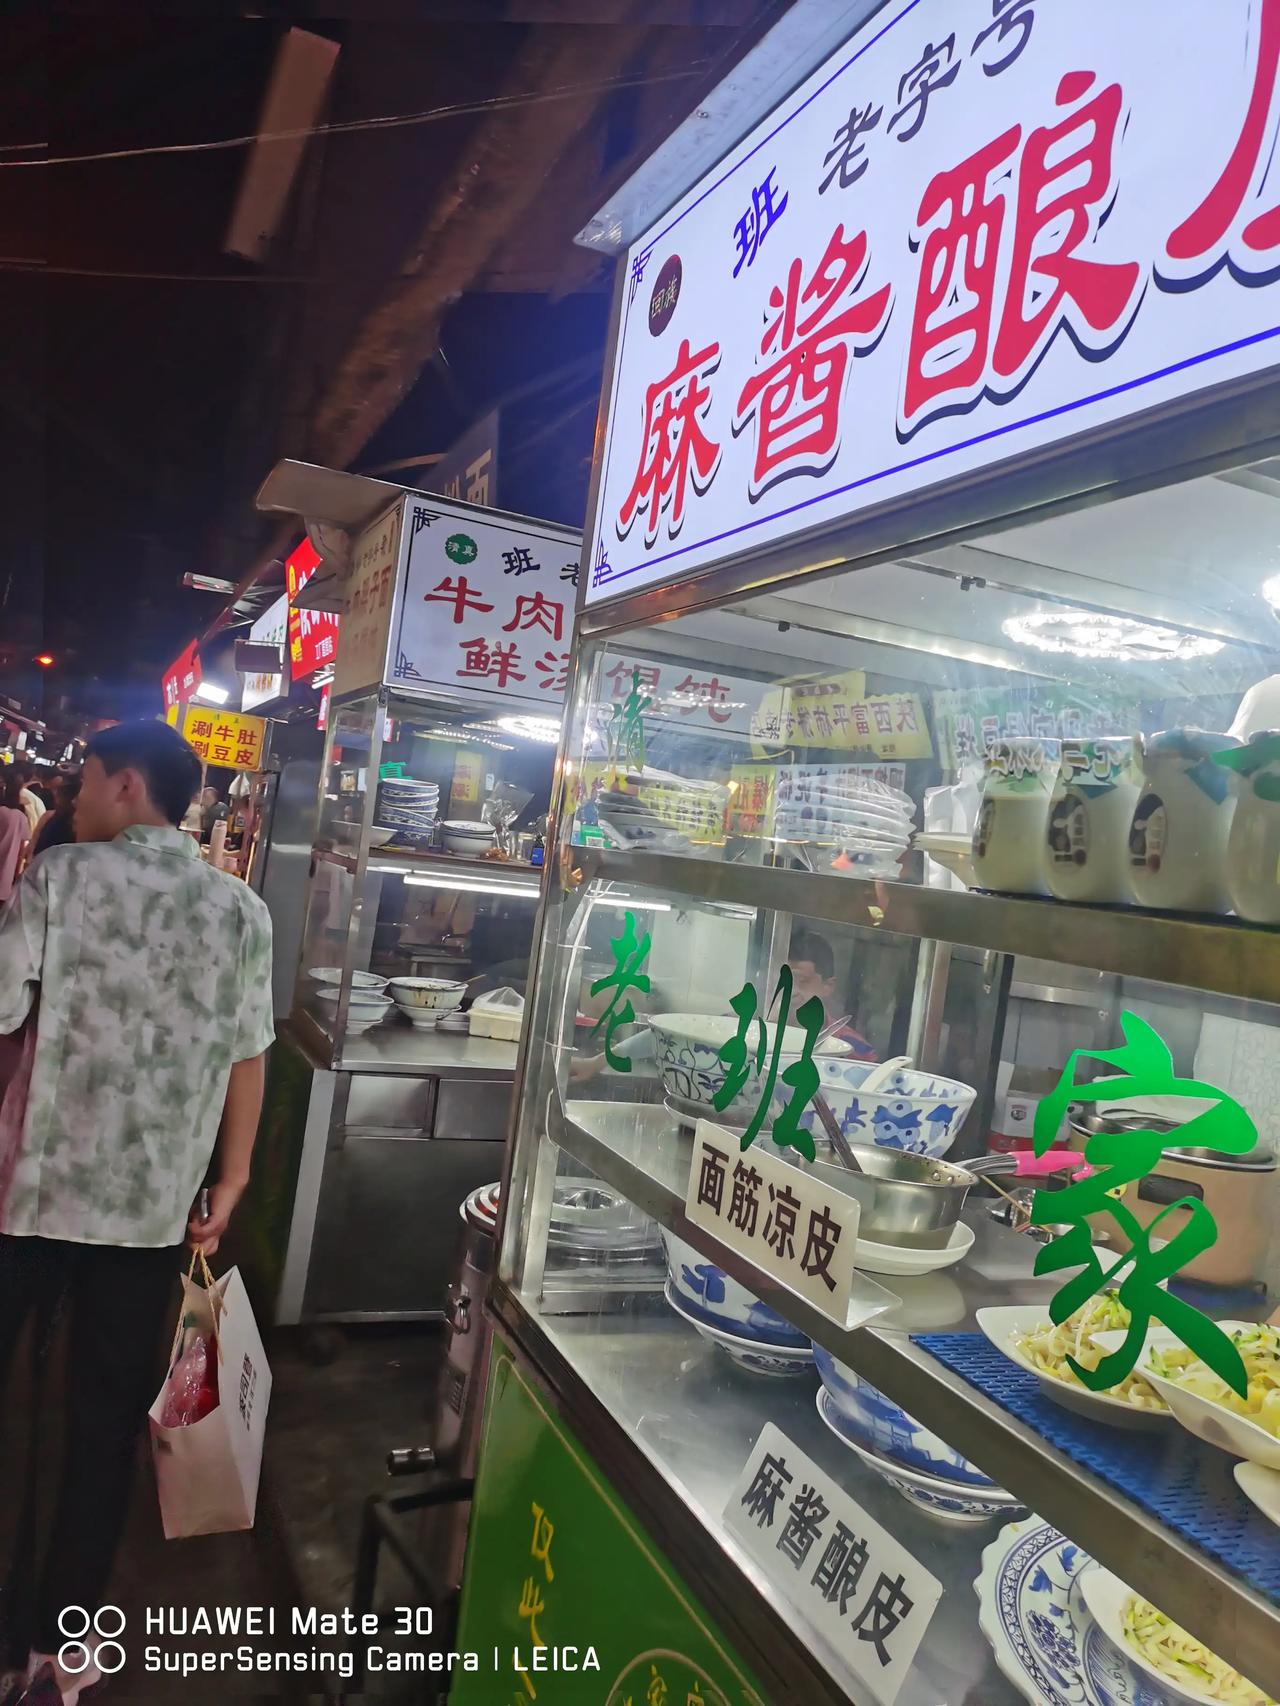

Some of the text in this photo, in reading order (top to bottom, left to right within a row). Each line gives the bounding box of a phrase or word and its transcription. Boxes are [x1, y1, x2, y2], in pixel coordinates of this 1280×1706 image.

[617, 0, 1280, 548] 麻酱酿
[423, 575, 564, 641] 牛肉
[190, 719, 259, 747] 涮牛肚
[696, 1141, 844, 1294] 面筋凉皮
[740, 1451, 915, 1667] 麻酱酿皮
